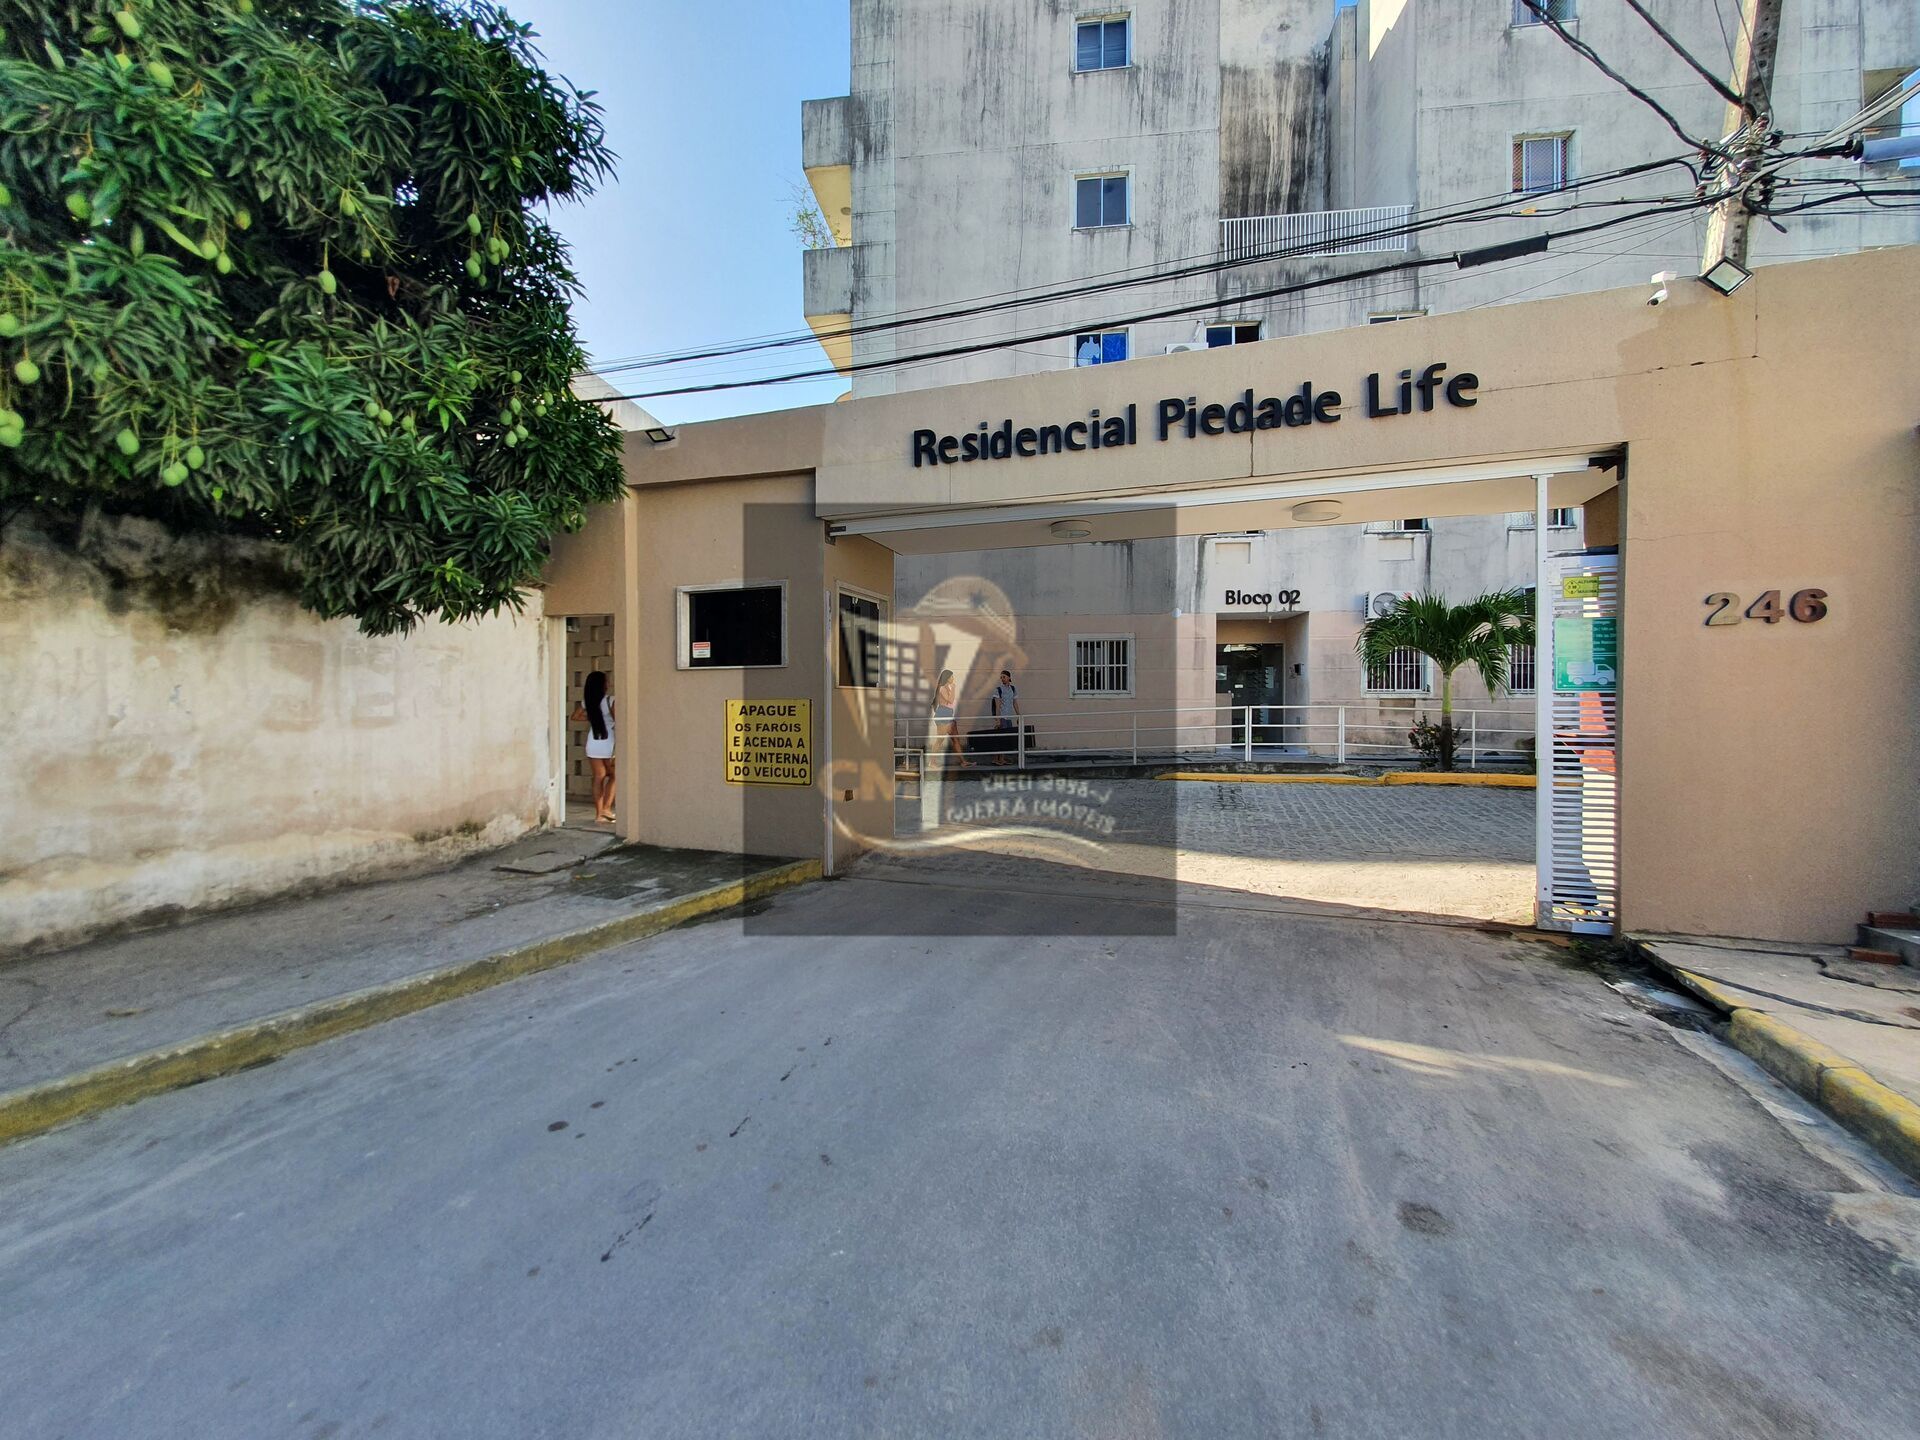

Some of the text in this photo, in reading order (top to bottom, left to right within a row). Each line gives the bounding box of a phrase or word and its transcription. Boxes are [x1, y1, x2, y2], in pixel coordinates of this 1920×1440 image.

[913, 362, 1479, 468] Residencial Piedade Life
[1225, 589, 1301, 605] Bloco 02
[1704, 588, 1829, 627] 246
[739, 705, 797, 716] APAGUE
[735, 721, 802, 732] OS FARÓIS
[733, 736, 805, 748] E ACENDA A
[729, 751, 809, 765] LUZ INTERNA
[734, 764, 807, 778] DO VEÍCULO
